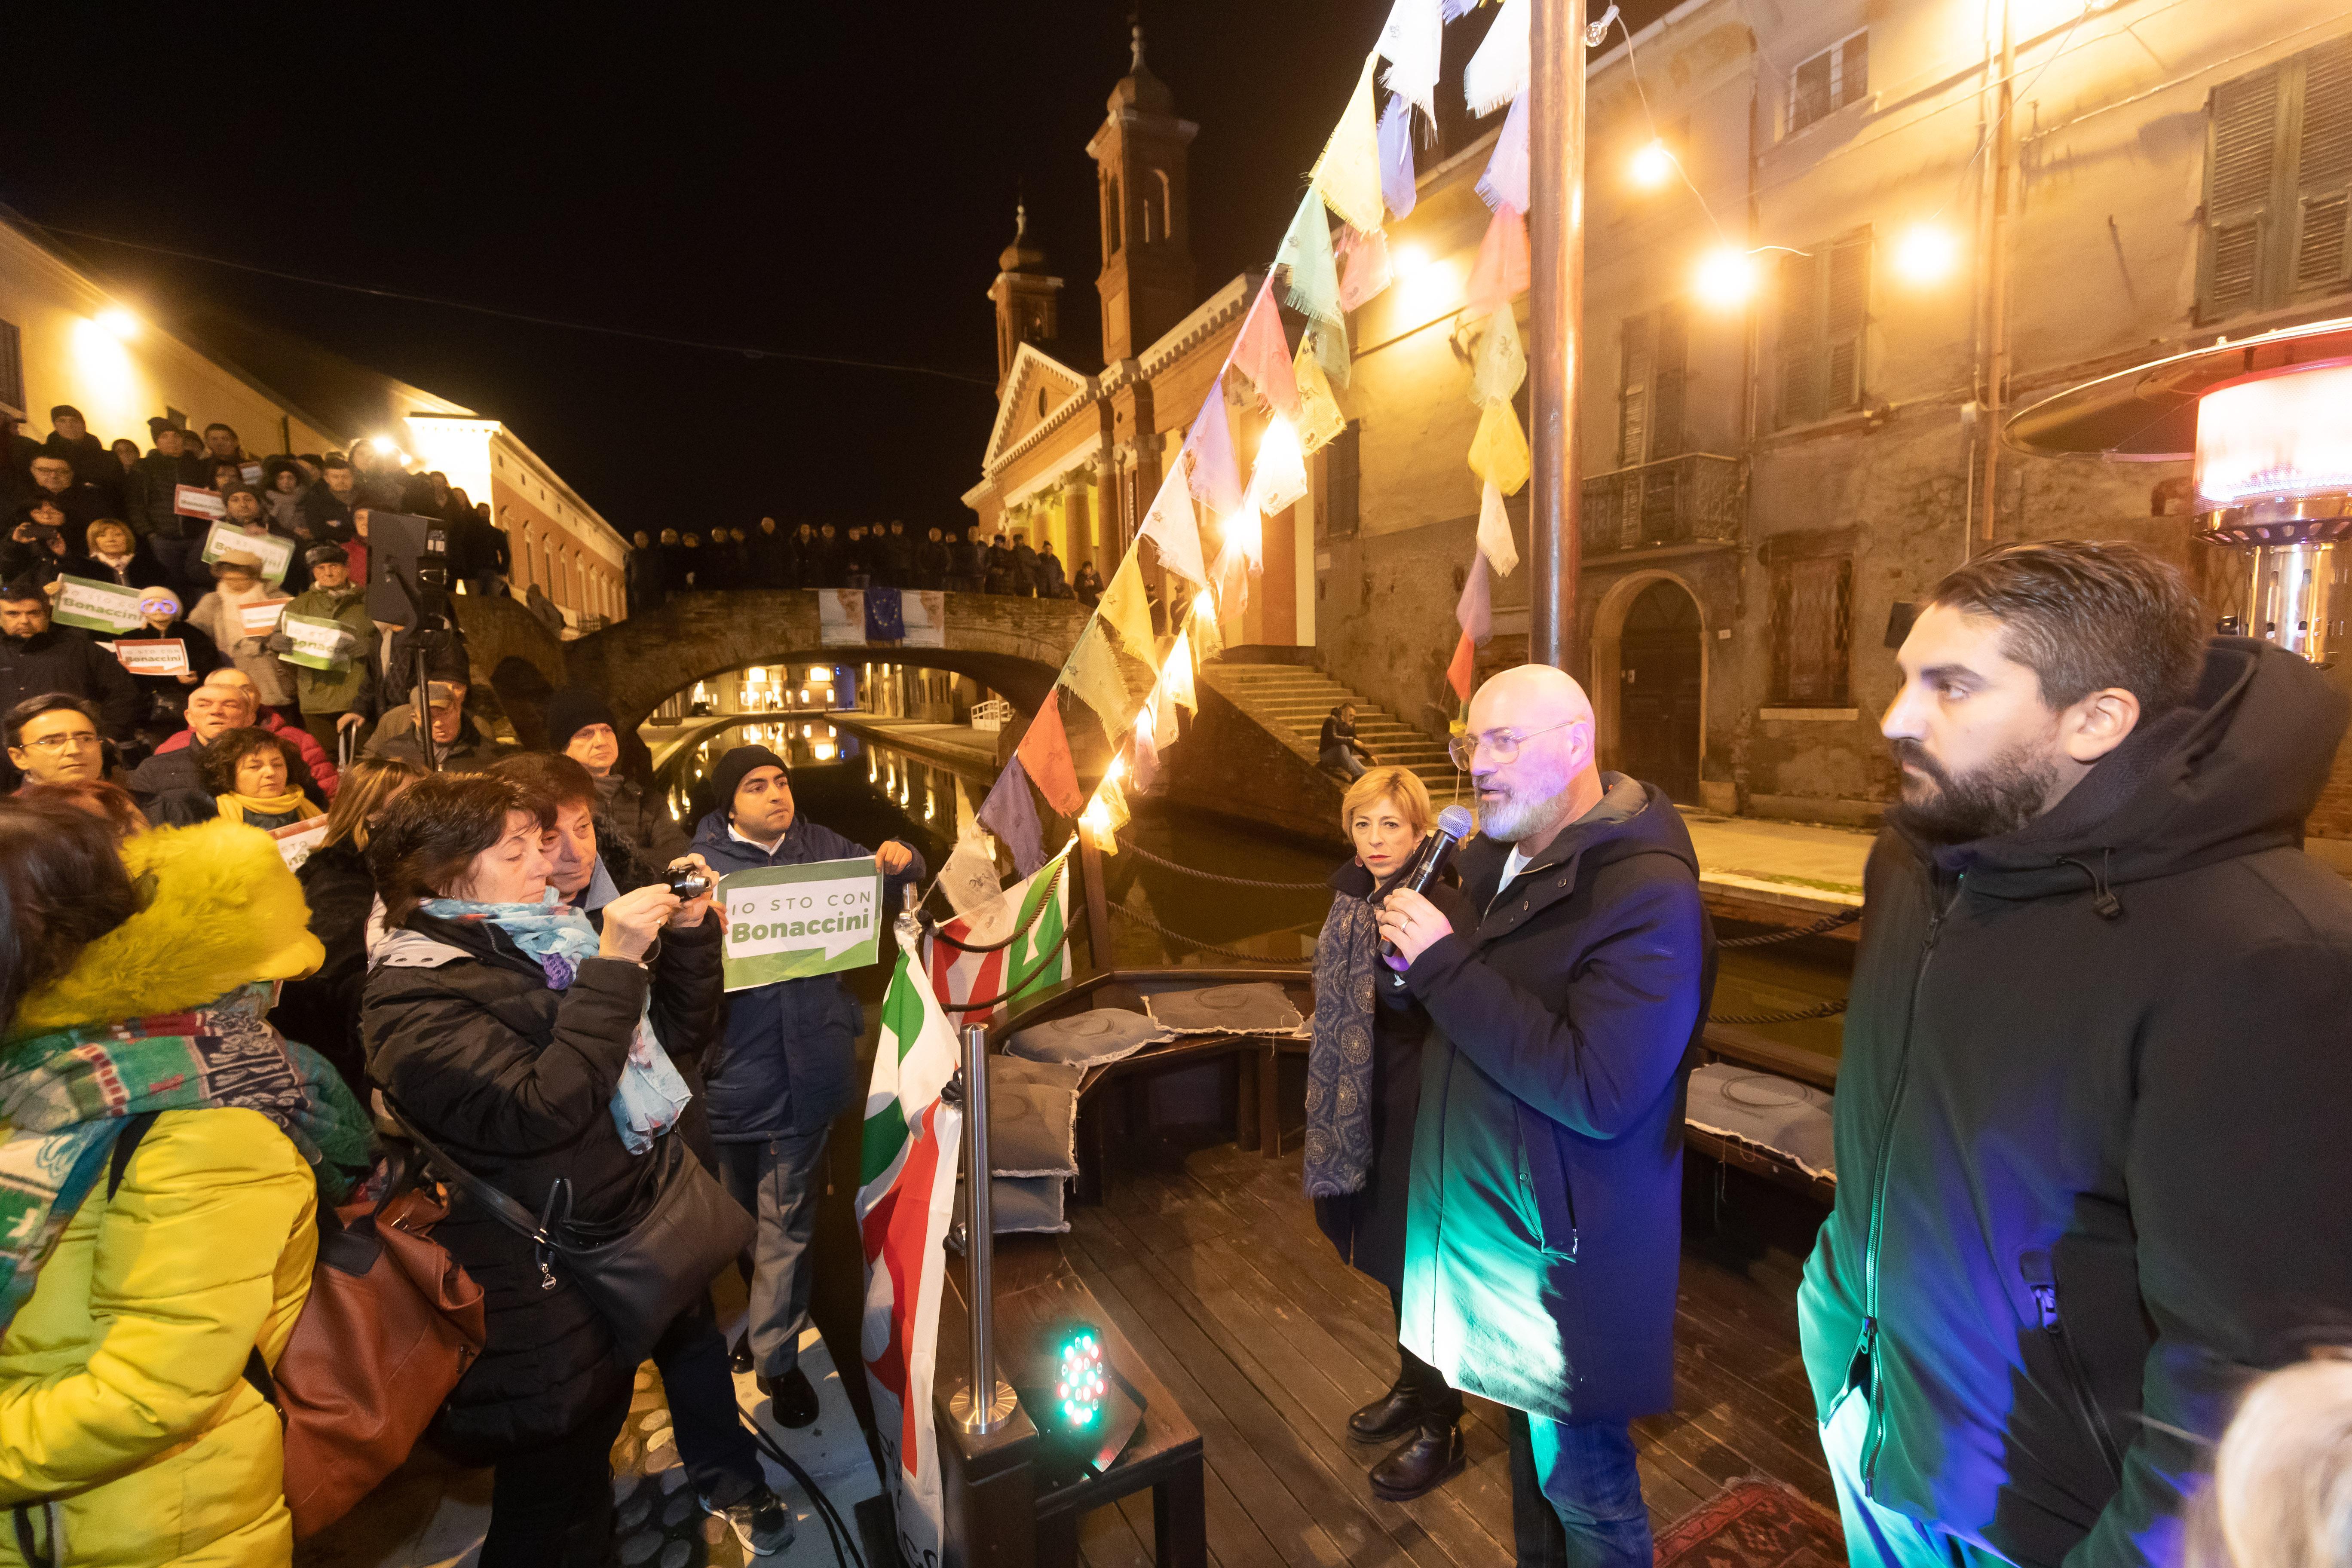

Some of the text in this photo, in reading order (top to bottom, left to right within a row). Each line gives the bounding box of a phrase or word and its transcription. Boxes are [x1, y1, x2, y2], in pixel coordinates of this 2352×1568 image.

[64, 597, 142, 621] Bonaccini
[125, 655, 181, 663] Bonaccini
[732, 891, 870, 916] IO STO CON
[732, 908, 869, 943] Bonaccini
